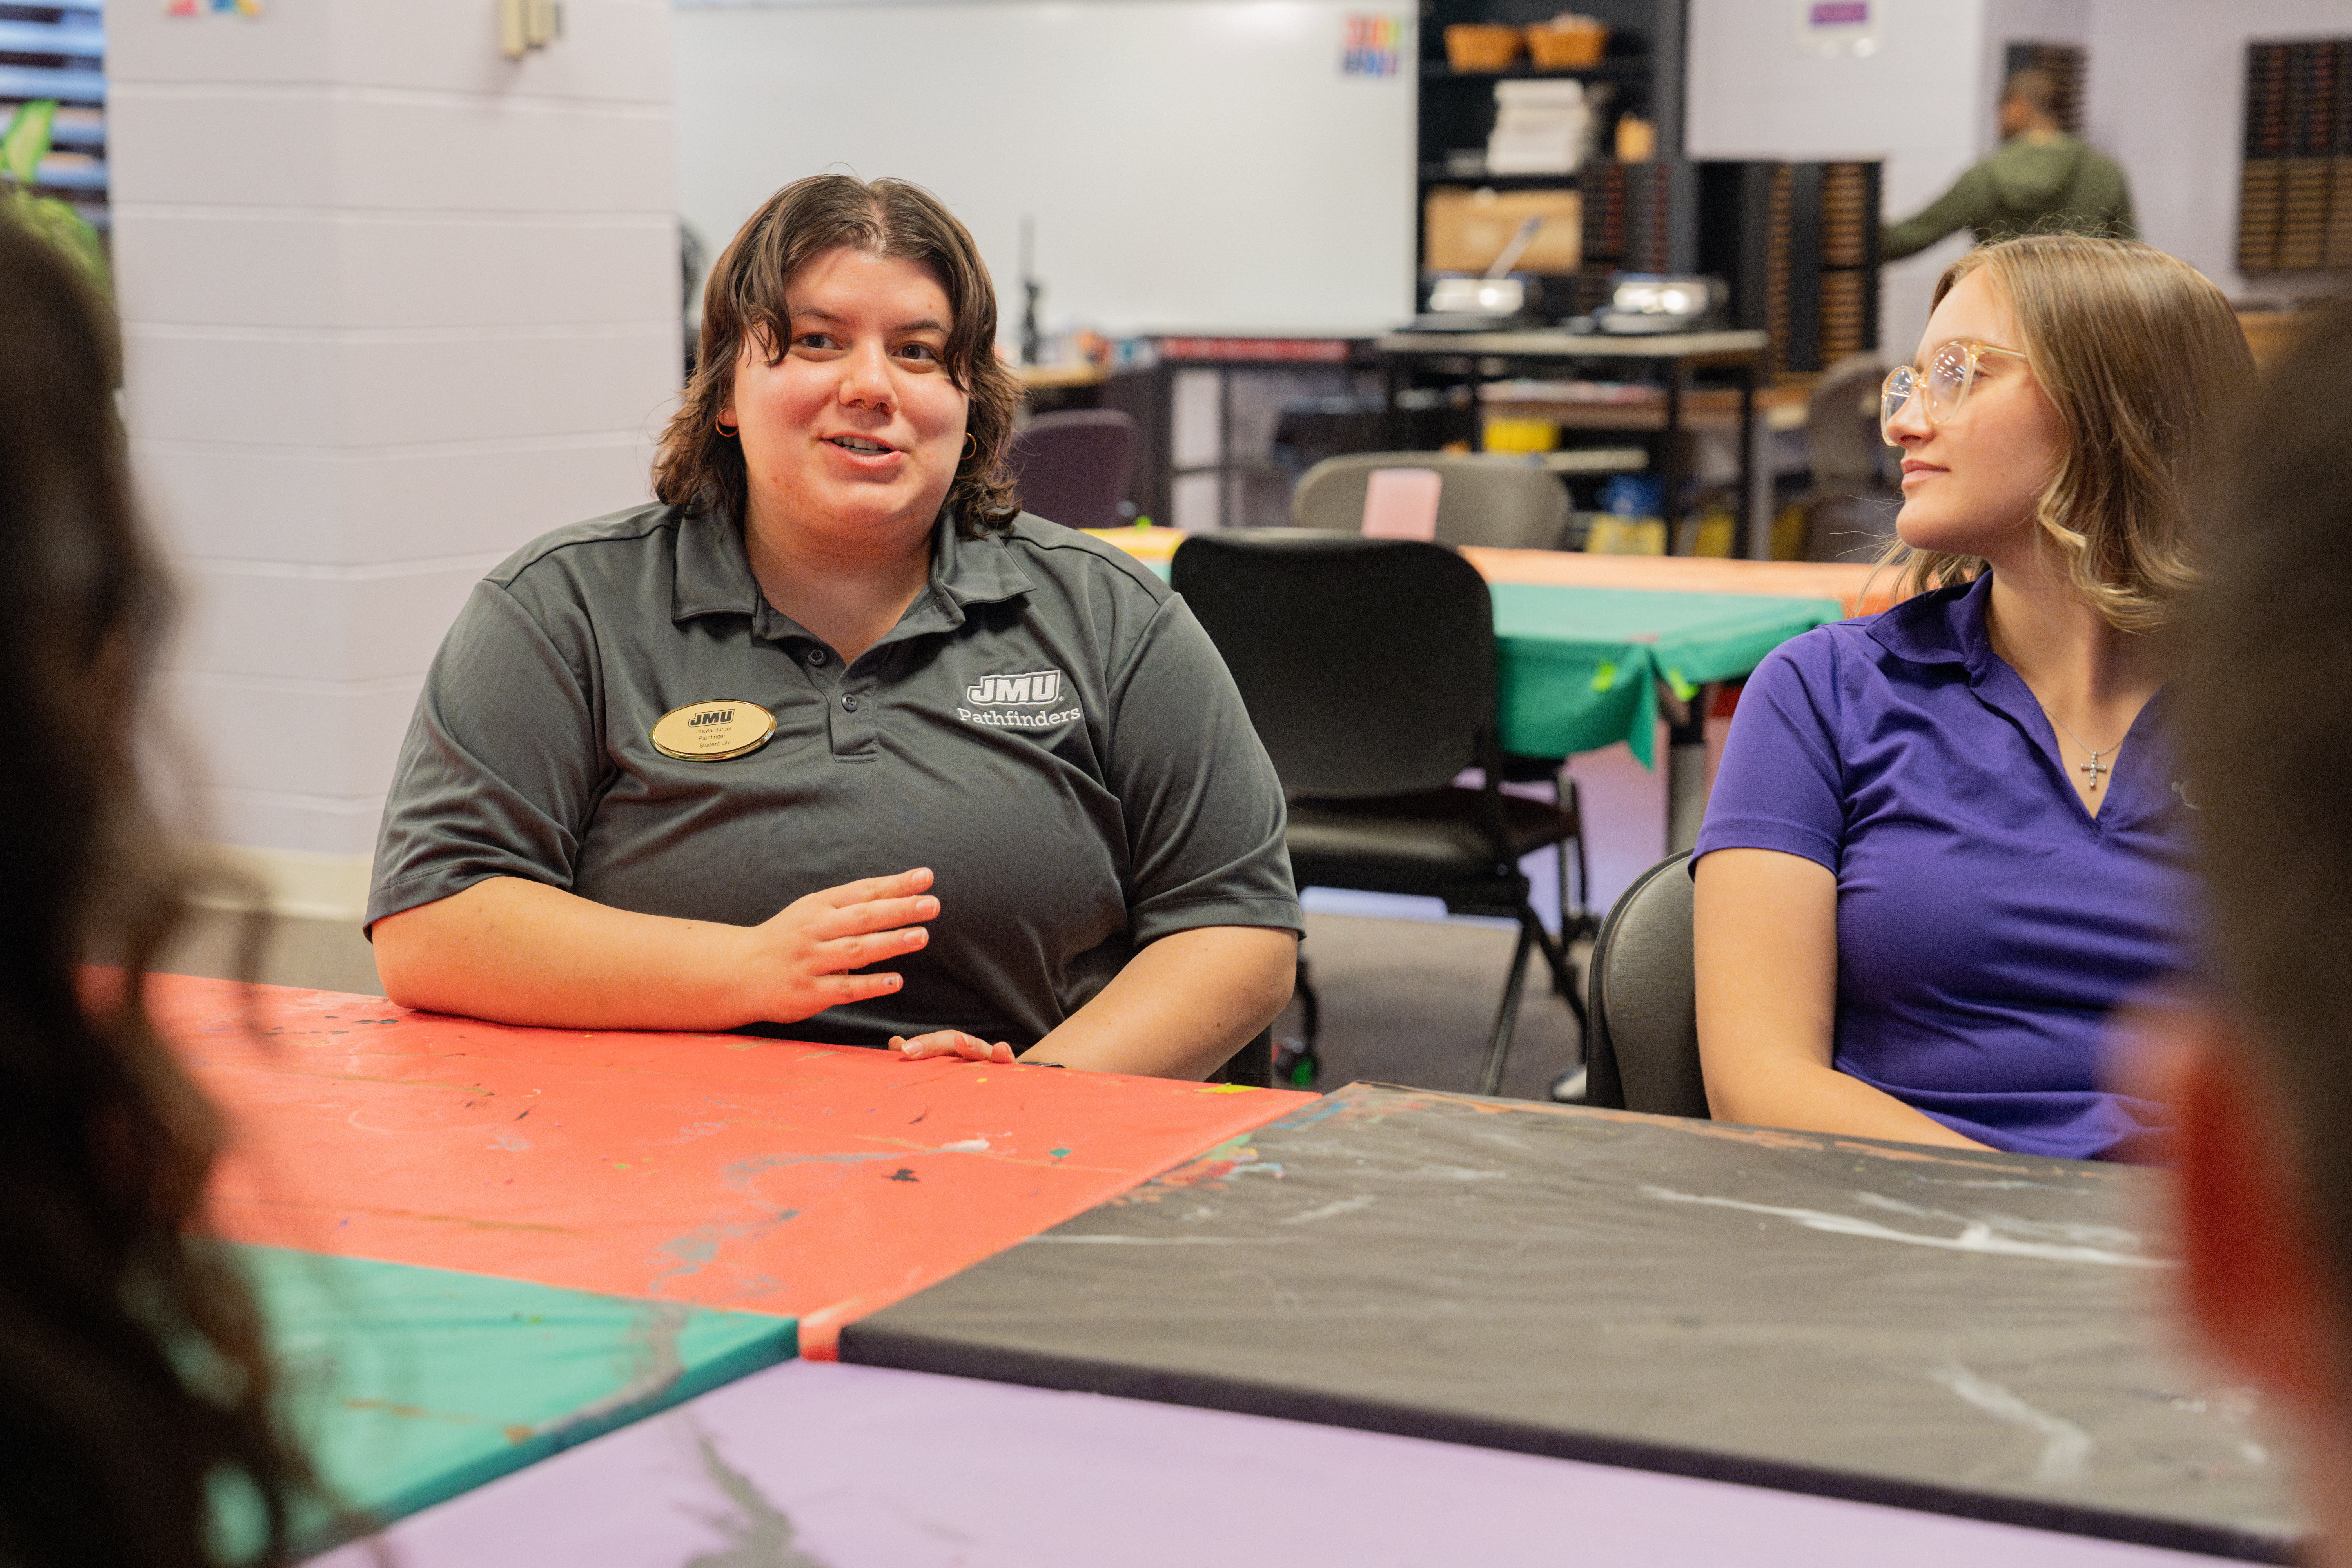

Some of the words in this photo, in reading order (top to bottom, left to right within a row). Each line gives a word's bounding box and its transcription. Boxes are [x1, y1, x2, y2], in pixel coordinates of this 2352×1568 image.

[971, 675, 1056, 701] JMU
[690, 711, 732, 725] JMU
[957, 708, 1080, 726] Pathfinders
